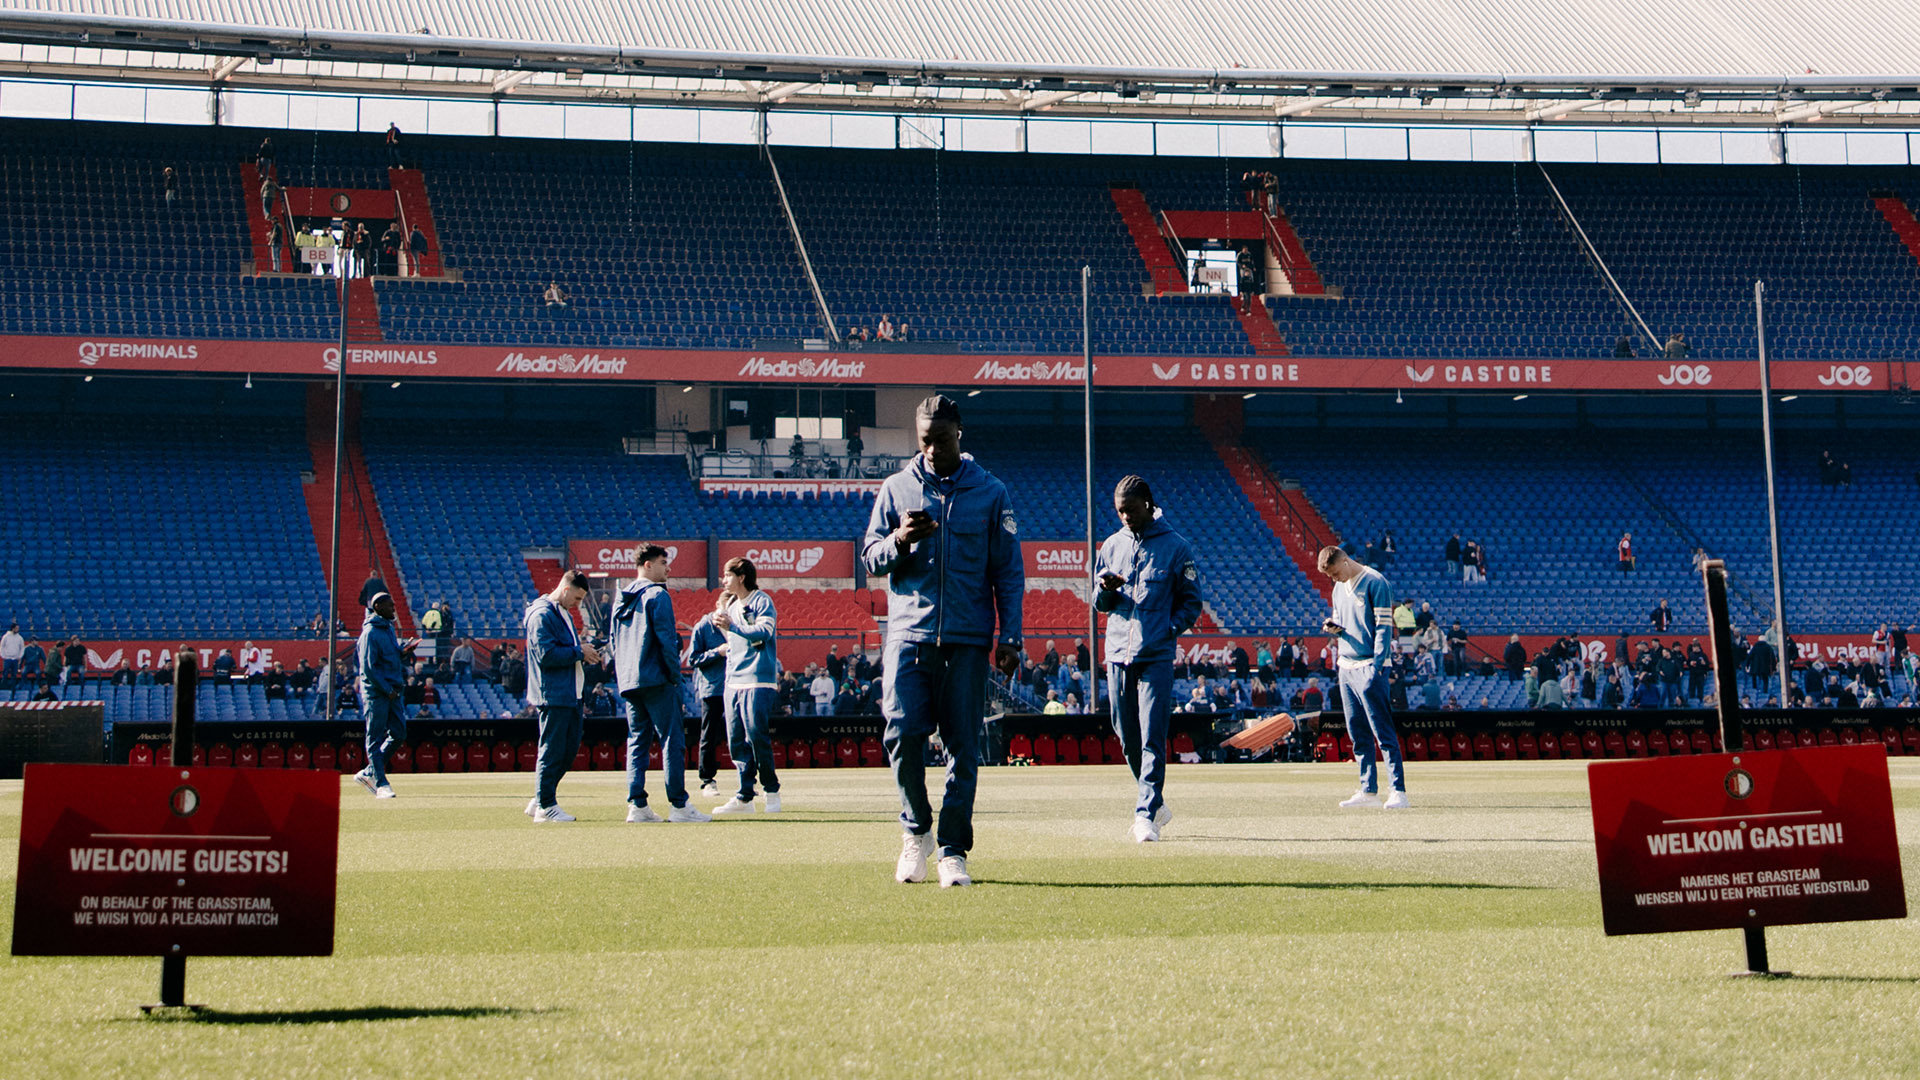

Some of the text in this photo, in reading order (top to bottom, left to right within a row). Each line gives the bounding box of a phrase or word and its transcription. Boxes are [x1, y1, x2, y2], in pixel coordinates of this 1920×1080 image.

[309, 250, 327, 260] BB
[1205, 271, 1222, 280] NN
[495, 352, 628, 374] Media Markt
[737, 357, 866, 378] Media Markt
[974, 360, 1032, 380] Media
[1190, 363, 1299, 381] CASTORE
[1445, 365, 1552, 383] CASTORE
[597, 547, 636, 563] CAR
[745, 548, 796, 564] CARU
[1036, 549, 1084, 564] CARU
[246, 731, 295, 740] CASTORE
[446, 729, 495, 737] CASTORE
[832, 726, 878, 734] CASTORE
[1646, 822, 1844, 856] WELKOM GASTEN!
[70, 847, 289, 874] WELCOME GUESTS!
[1680, 868, 1821, 889] NAMENS HET GRASTEAM
[1634, 879, 1870, 906] WENSEN WIJ U EEN PRETTIGE WEDSTRIJD
[80, 895, 274, 912] ON BEHALF OF THE GRASSTEAM,
[74, 911, 279, 926] WE WISH YOU A PLEASANT MATCH
